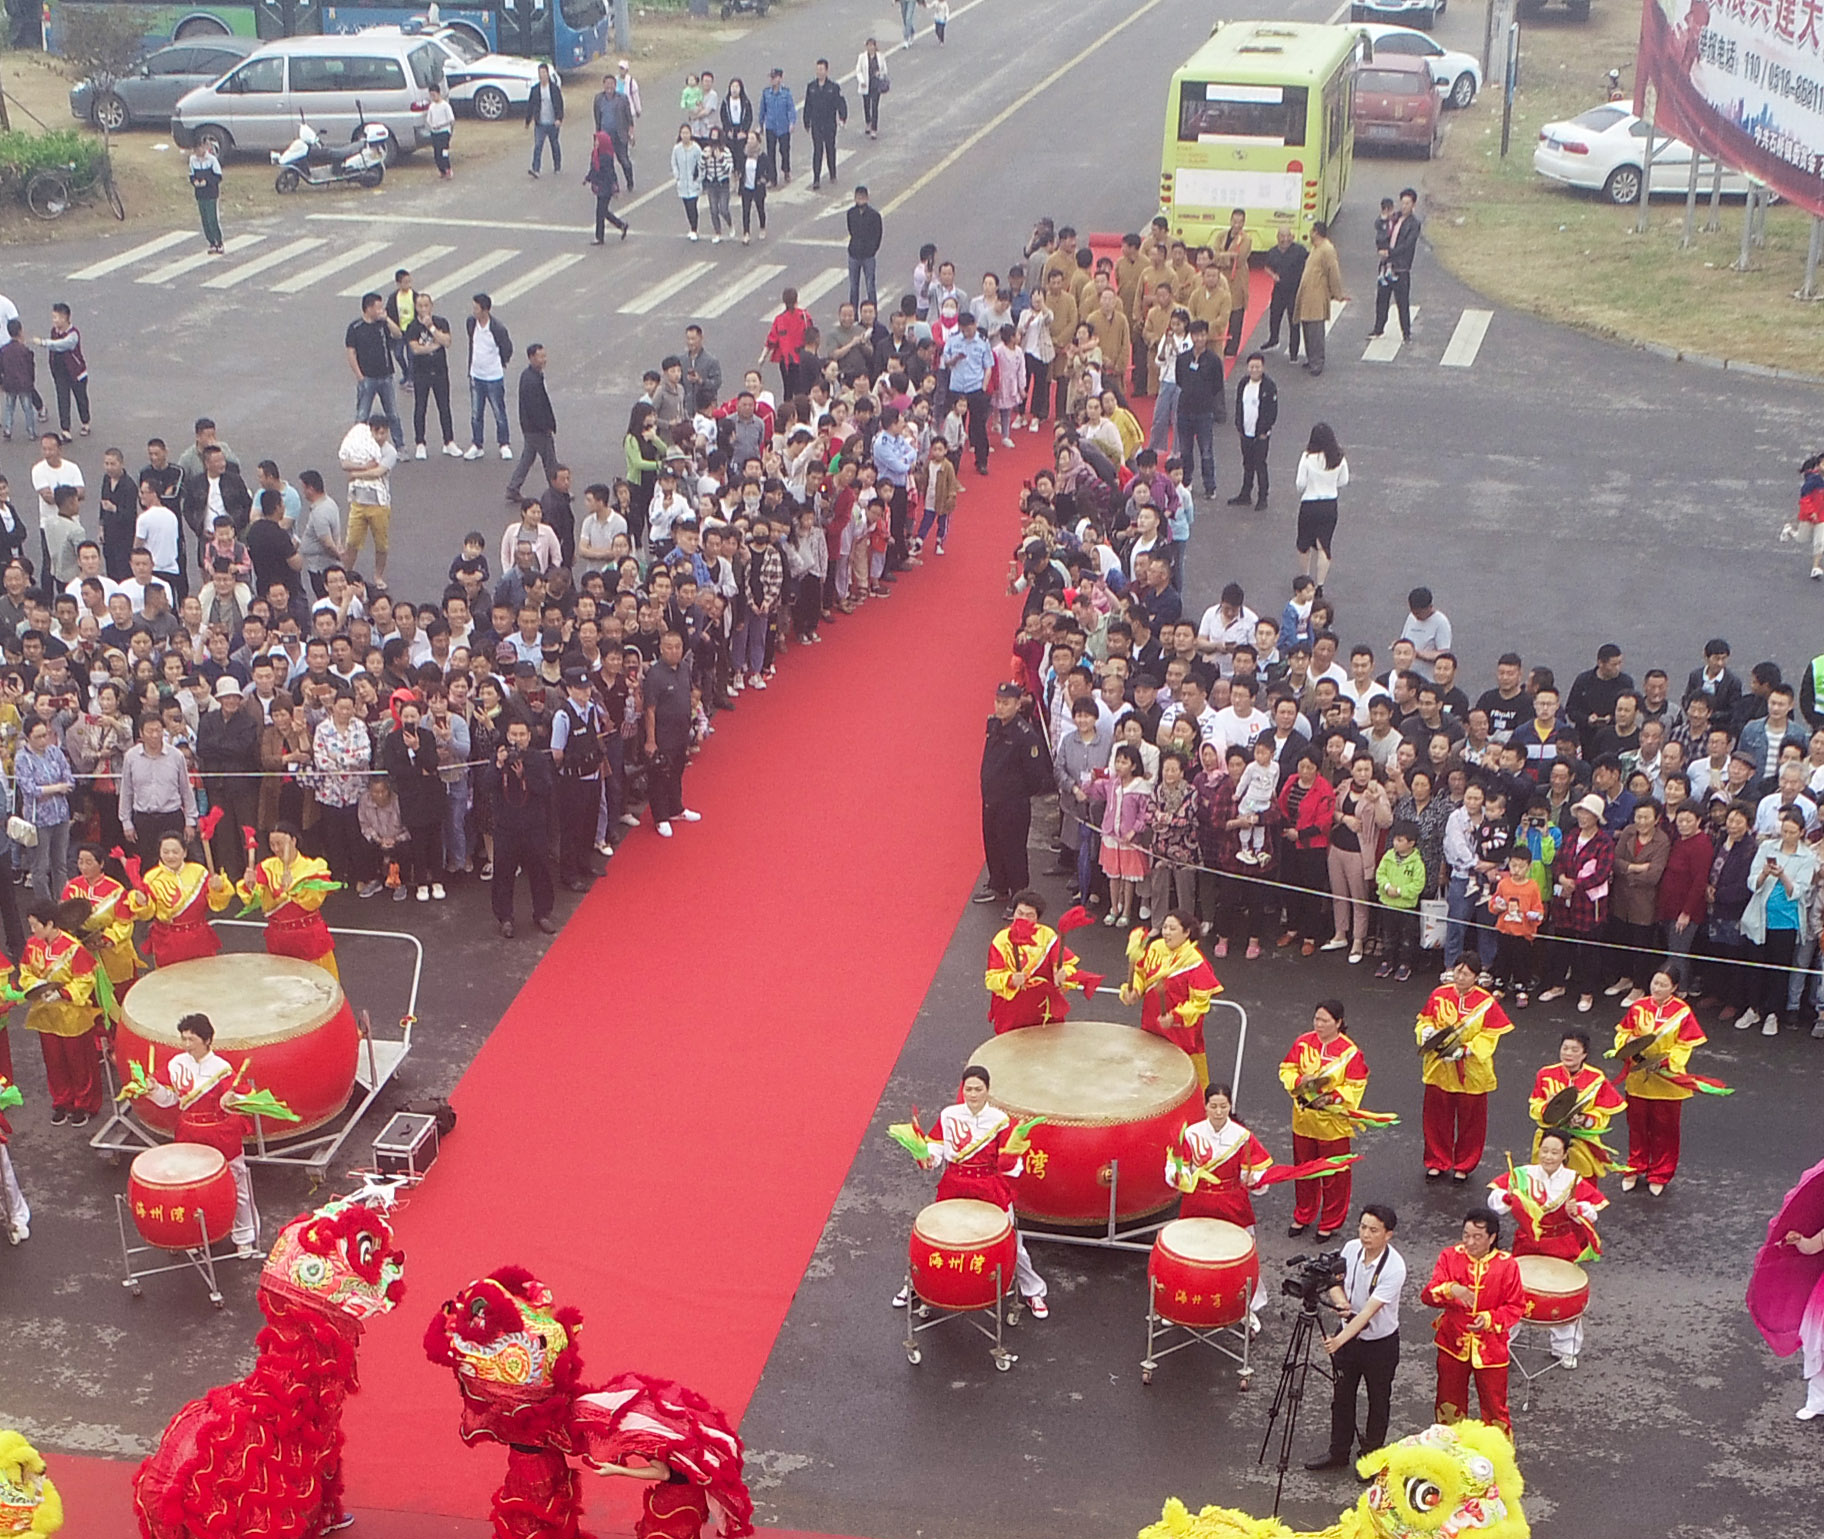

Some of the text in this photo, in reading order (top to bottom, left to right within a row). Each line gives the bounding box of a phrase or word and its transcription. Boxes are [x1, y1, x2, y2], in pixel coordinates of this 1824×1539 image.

[1026, 1149, 1049, 1180] 湾
[929, 1251, 986, 1275] 海州湾
